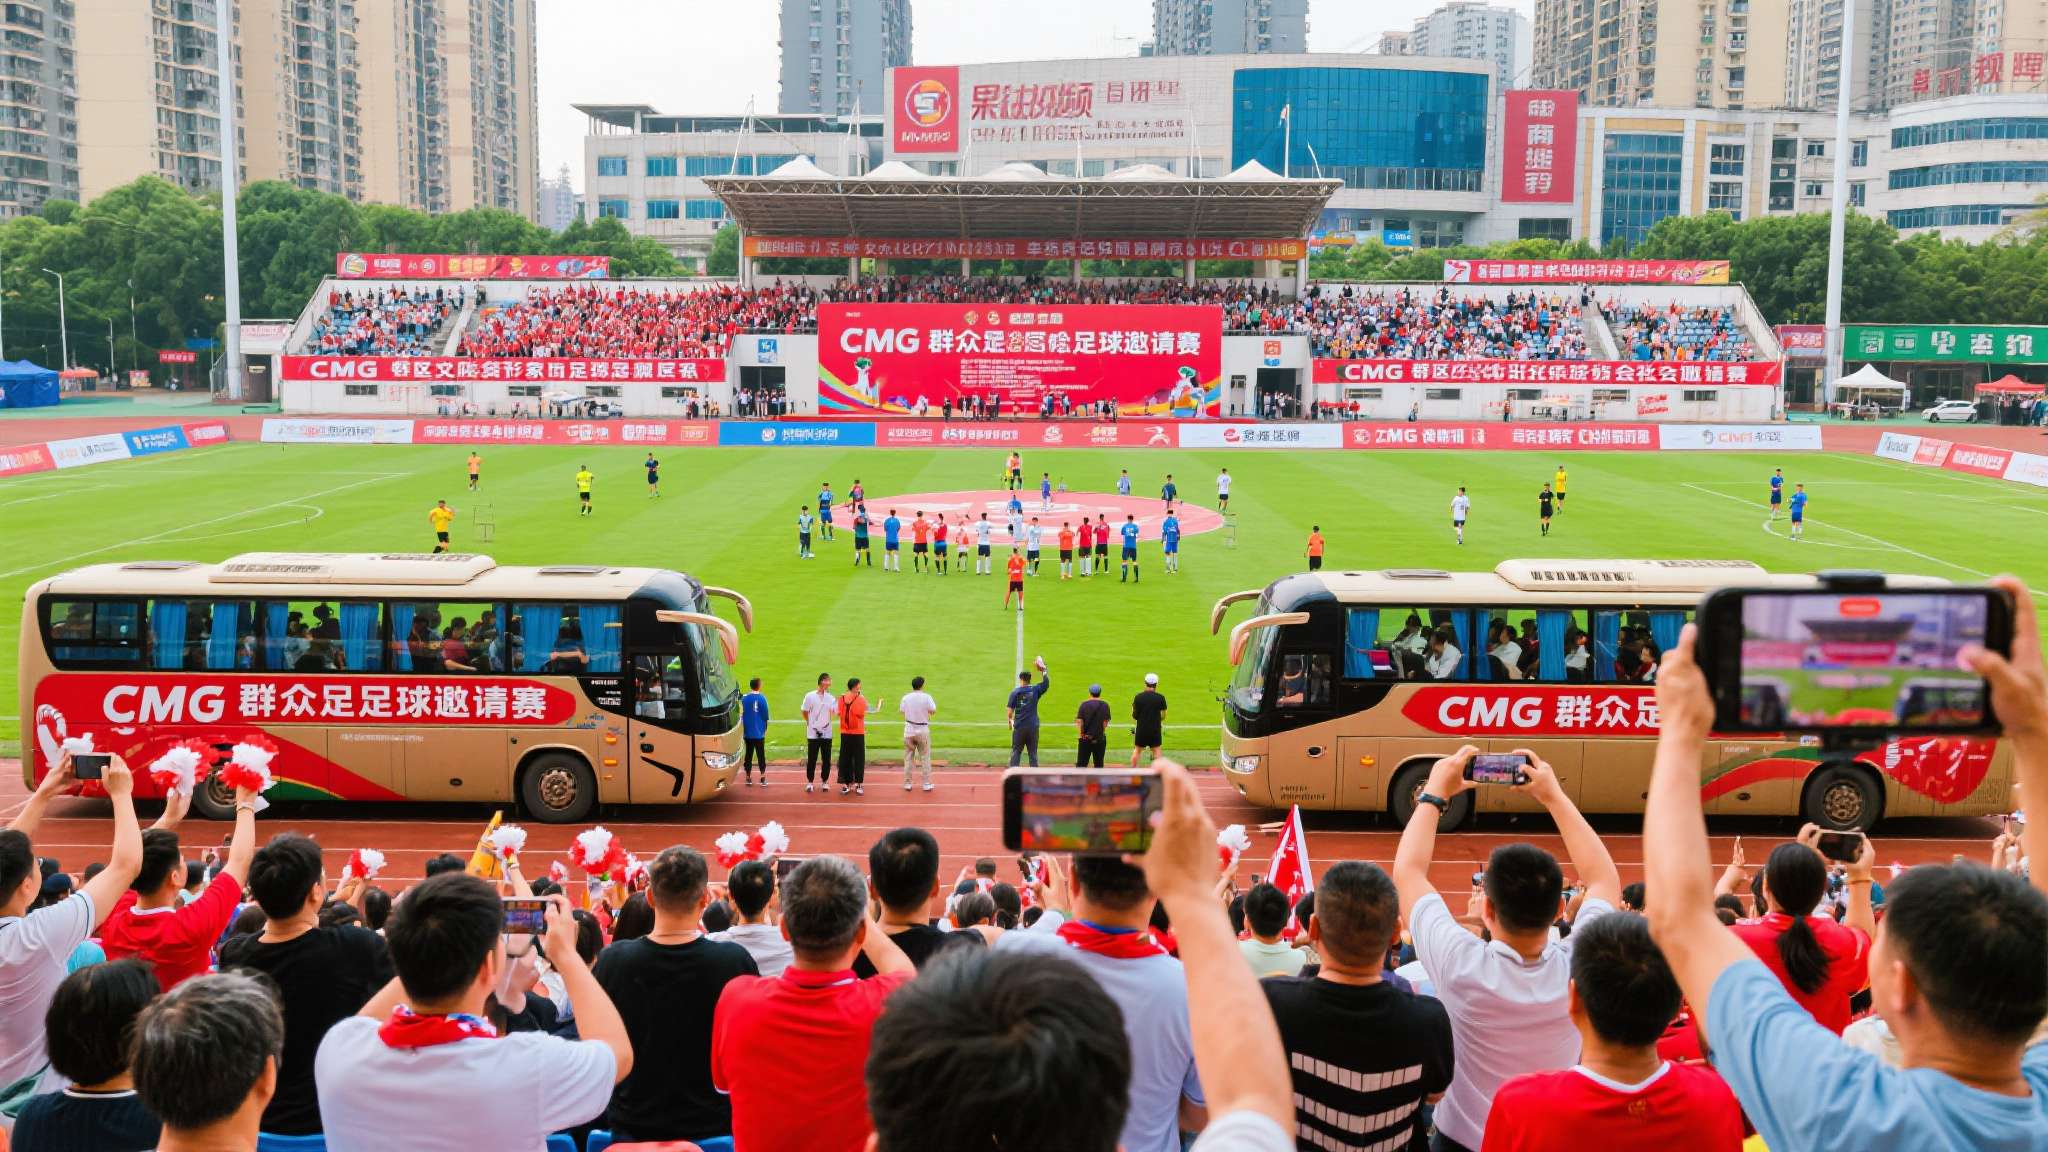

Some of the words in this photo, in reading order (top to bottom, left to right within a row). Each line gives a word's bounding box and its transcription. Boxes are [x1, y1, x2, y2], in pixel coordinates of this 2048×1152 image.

[840, 327, 921, 353] CMG
[310, 360, 378, 378] CMG
[1344, 363, 1403, 380] CMG
[103, 685, 225, 723] CMG
[239, 683, 547, 719] 群众足足球邀请赛
[1438, 696, 1543, 728] CMG
